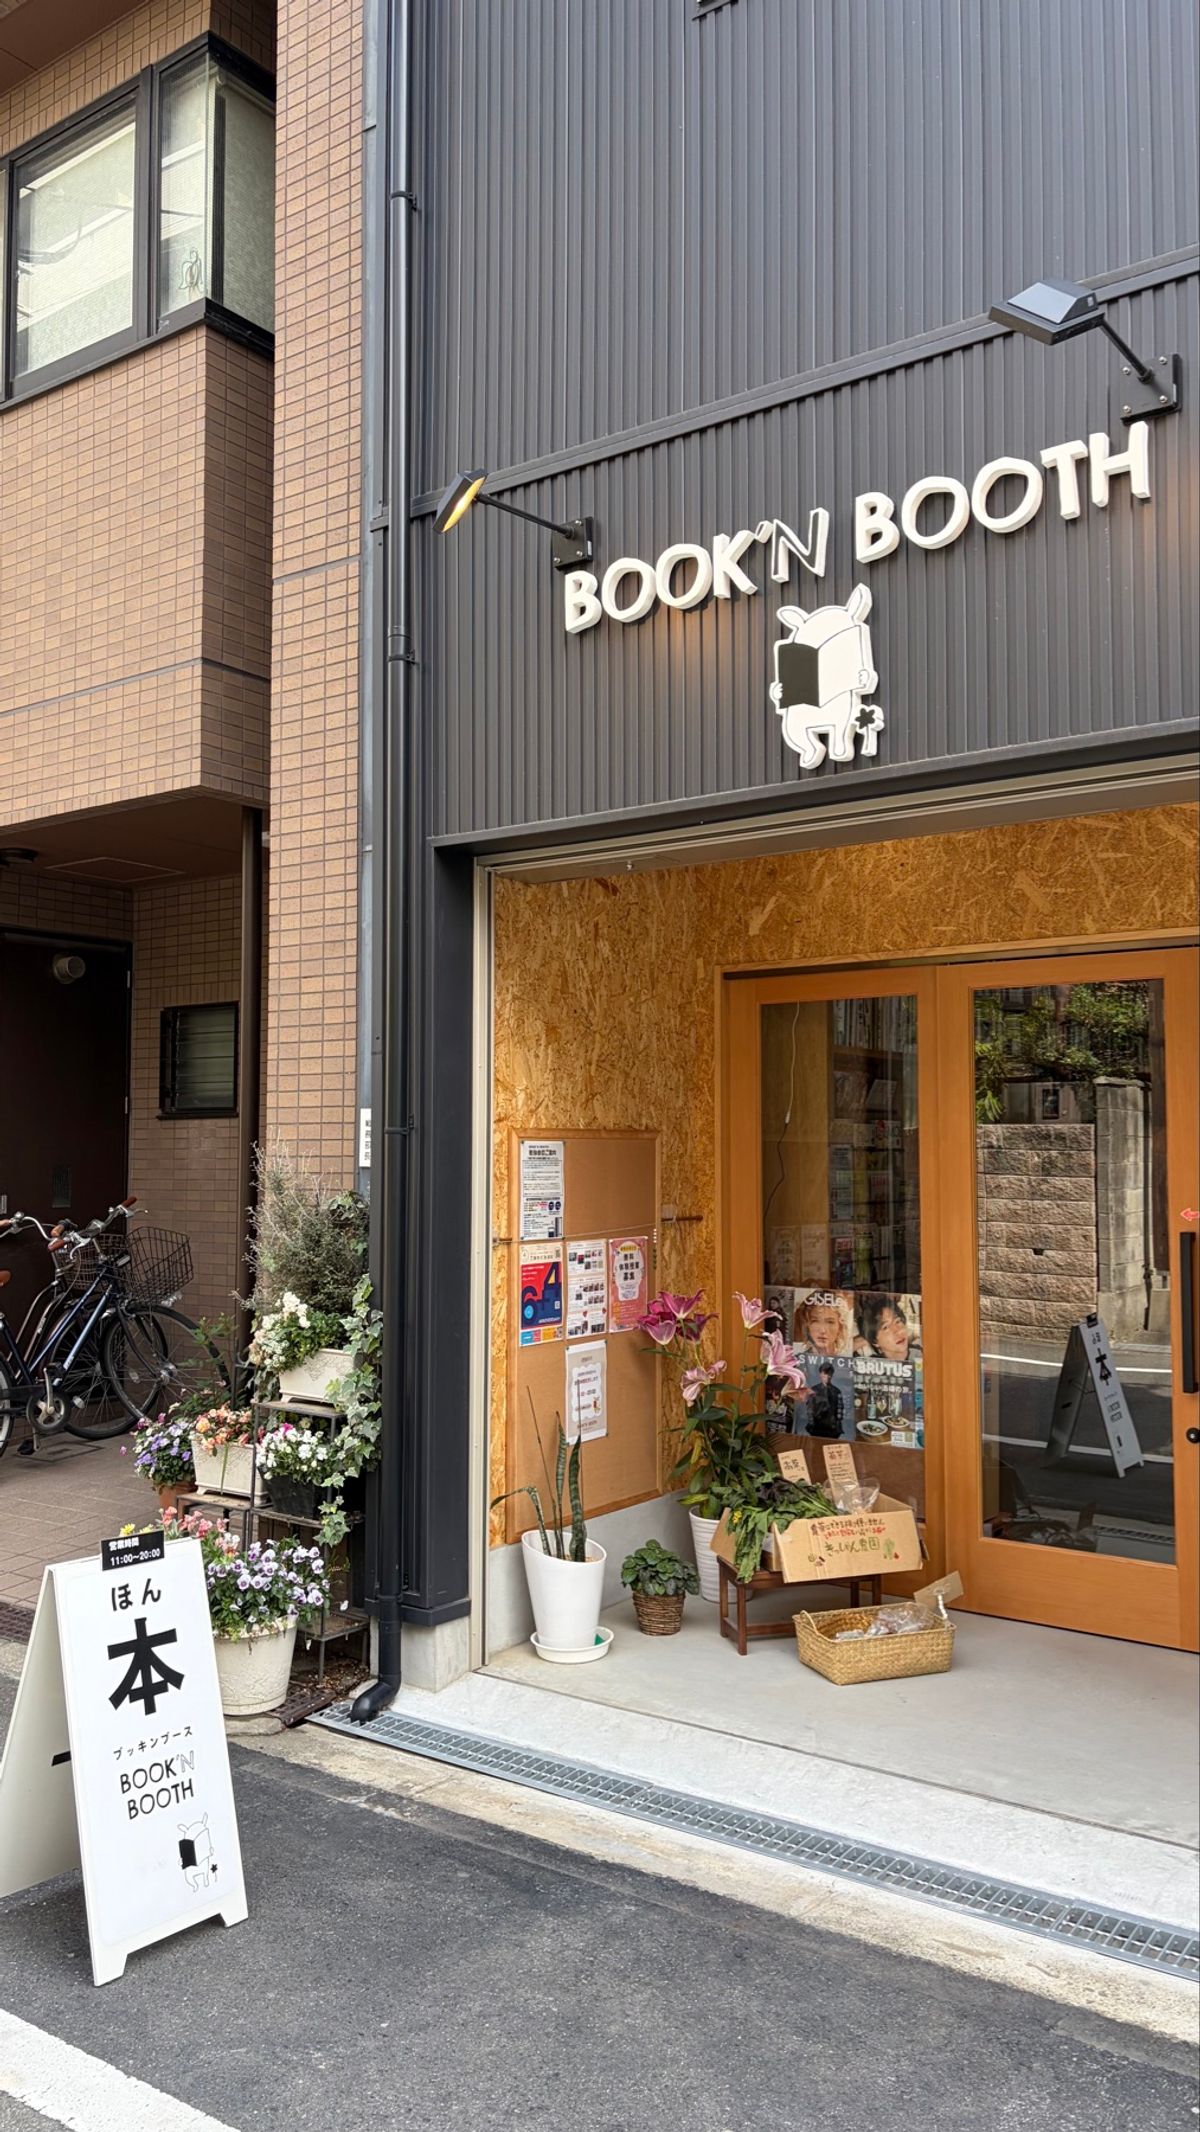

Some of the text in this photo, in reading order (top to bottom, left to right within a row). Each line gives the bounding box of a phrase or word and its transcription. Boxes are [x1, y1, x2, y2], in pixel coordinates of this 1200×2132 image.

[564, 421, 1150, 634] BOOK'N BOOTH
[799, 1354, 854, 1369] SWITCH
[856, 1359, 913, 1378] BRUTUS
[109, 1537, 140, 1551] 営業時間
[111, 1577, 162, 1612] ほん
[107, 1617, 184, 1716] 本
[113, 1726, 193, 1761] ブッキンブース
[120, 1750, 195, 1795] BOOK'N
[128, 1778, 194, 1820] BOOTH
